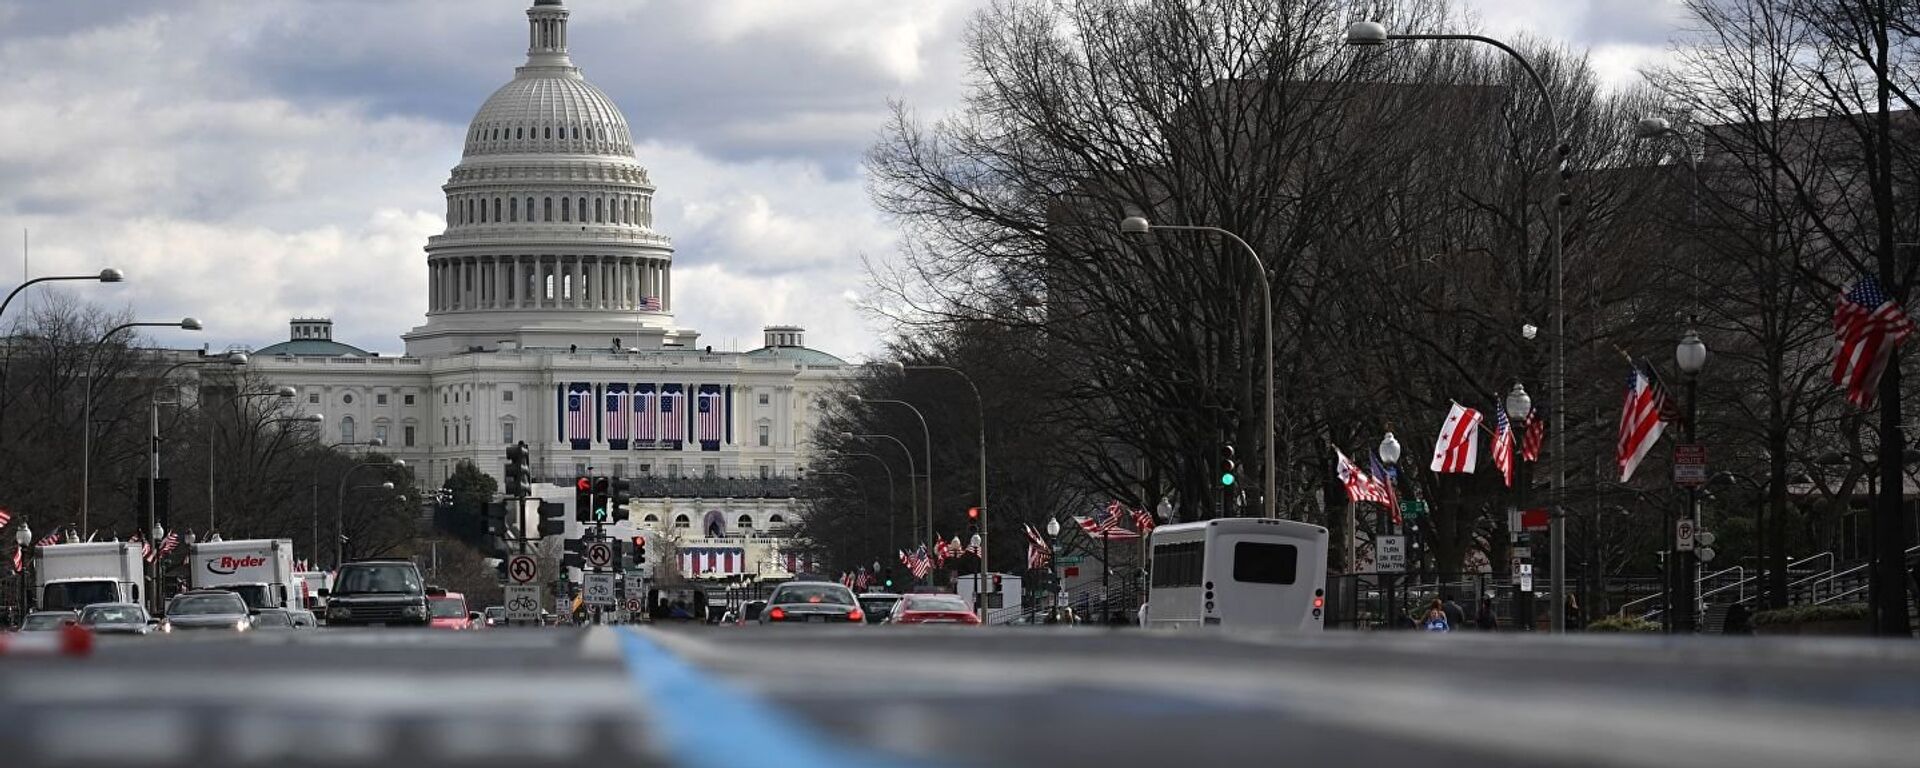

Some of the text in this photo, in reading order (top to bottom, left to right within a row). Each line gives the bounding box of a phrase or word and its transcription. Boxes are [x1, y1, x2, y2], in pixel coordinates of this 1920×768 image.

[221, 554, 266, 570] Ryder
[1379, 554, 1403, 562] ON RED
